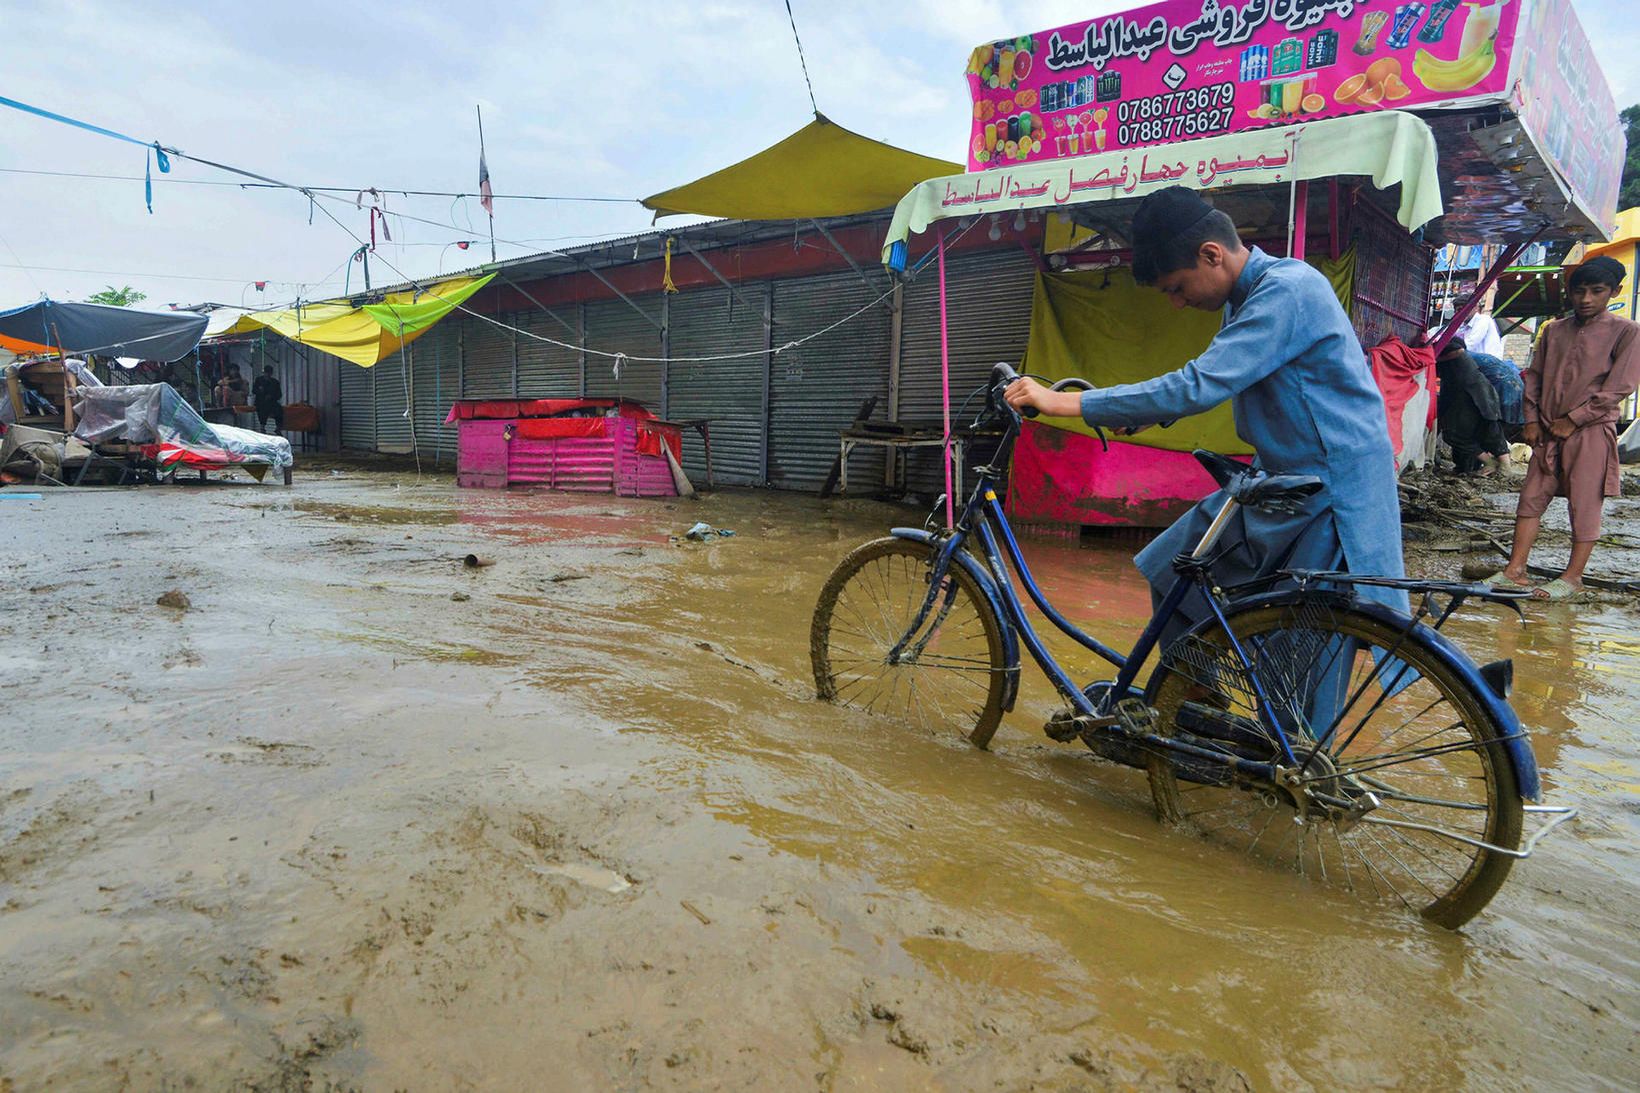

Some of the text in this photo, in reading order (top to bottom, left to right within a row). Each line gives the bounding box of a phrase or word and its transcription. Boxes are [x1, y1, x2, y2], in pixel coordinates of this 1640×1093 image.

[1046, 16, 1167, 69] عبدالباسط
[1168, 0, 1268, 54] فروشی
[1118, 82, 1234, 122] 0786773679
[1118, 107, 1234, 144] 0788775627
[942, 176, 1051, 213] عبدالباسط
